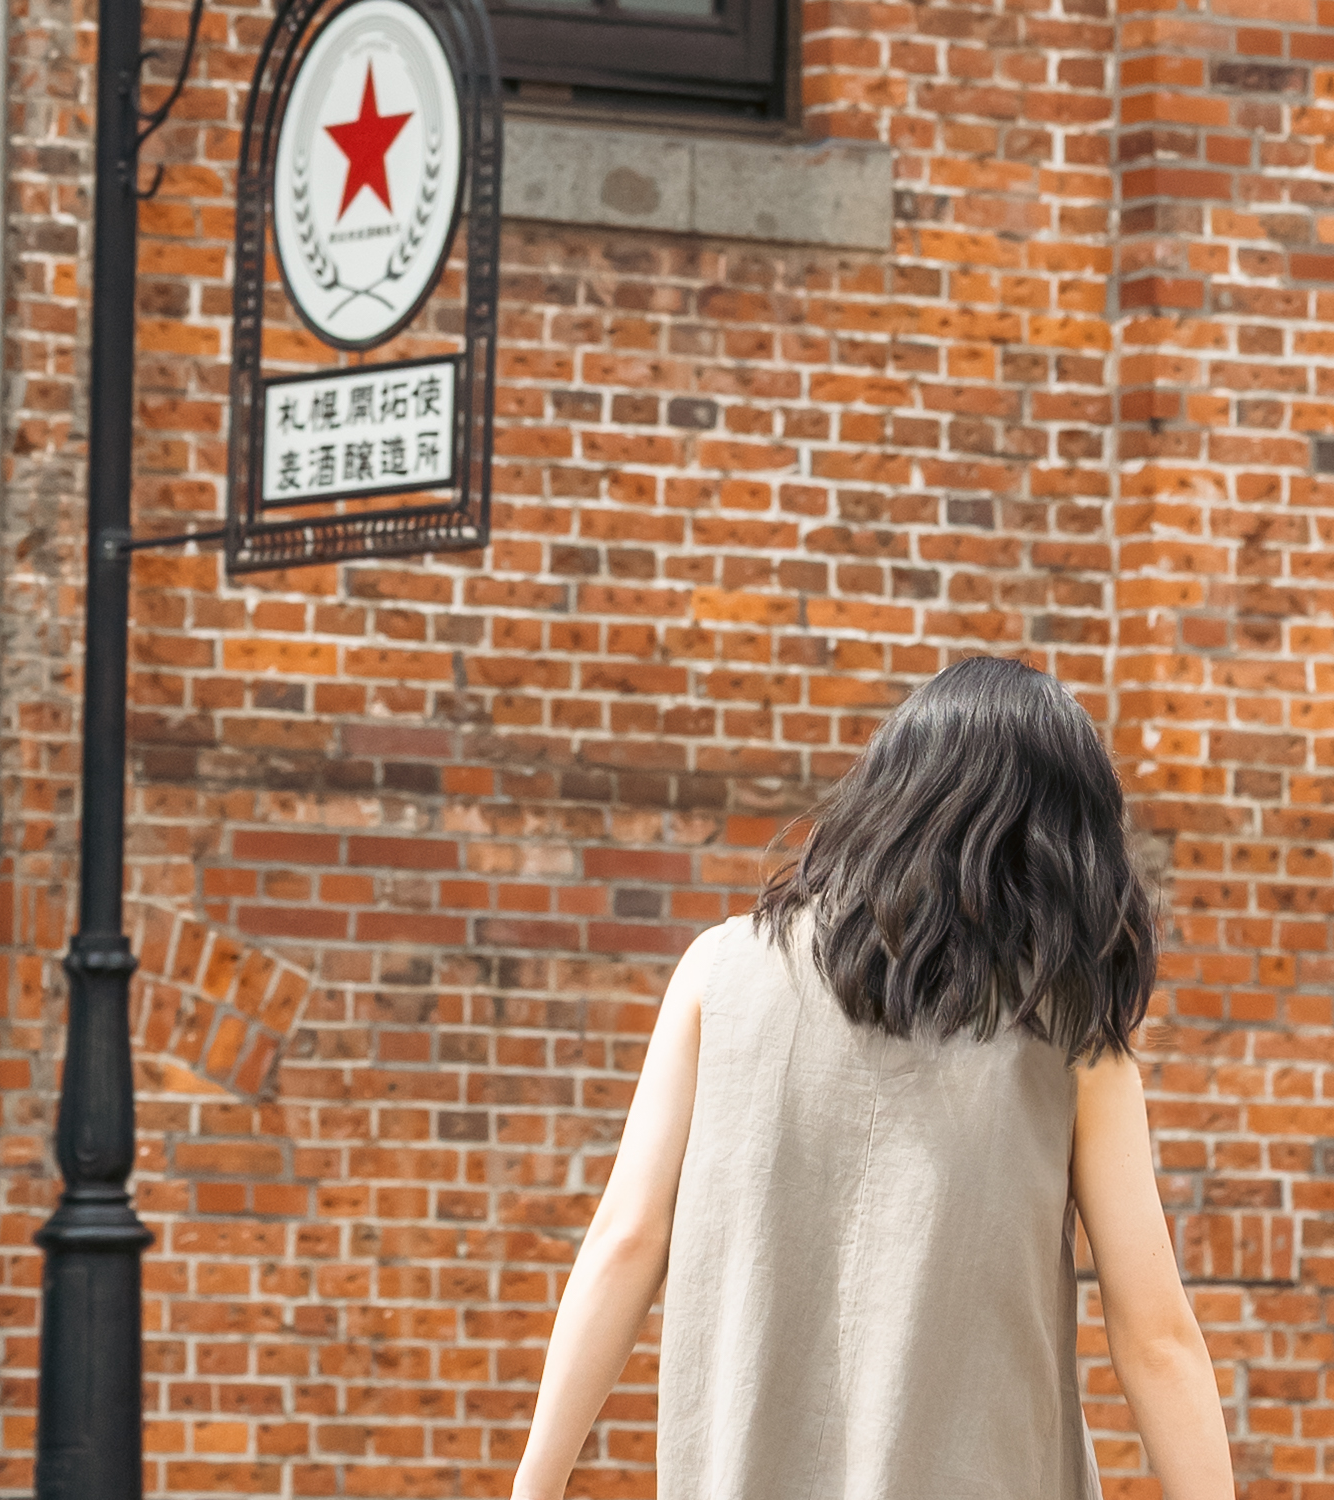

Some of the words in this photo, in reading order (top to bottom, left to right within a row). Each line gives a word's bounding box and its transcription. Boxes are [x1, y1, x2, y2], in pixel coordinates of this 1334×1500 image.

[277, 373, 441, 436] 札幌開拓使
